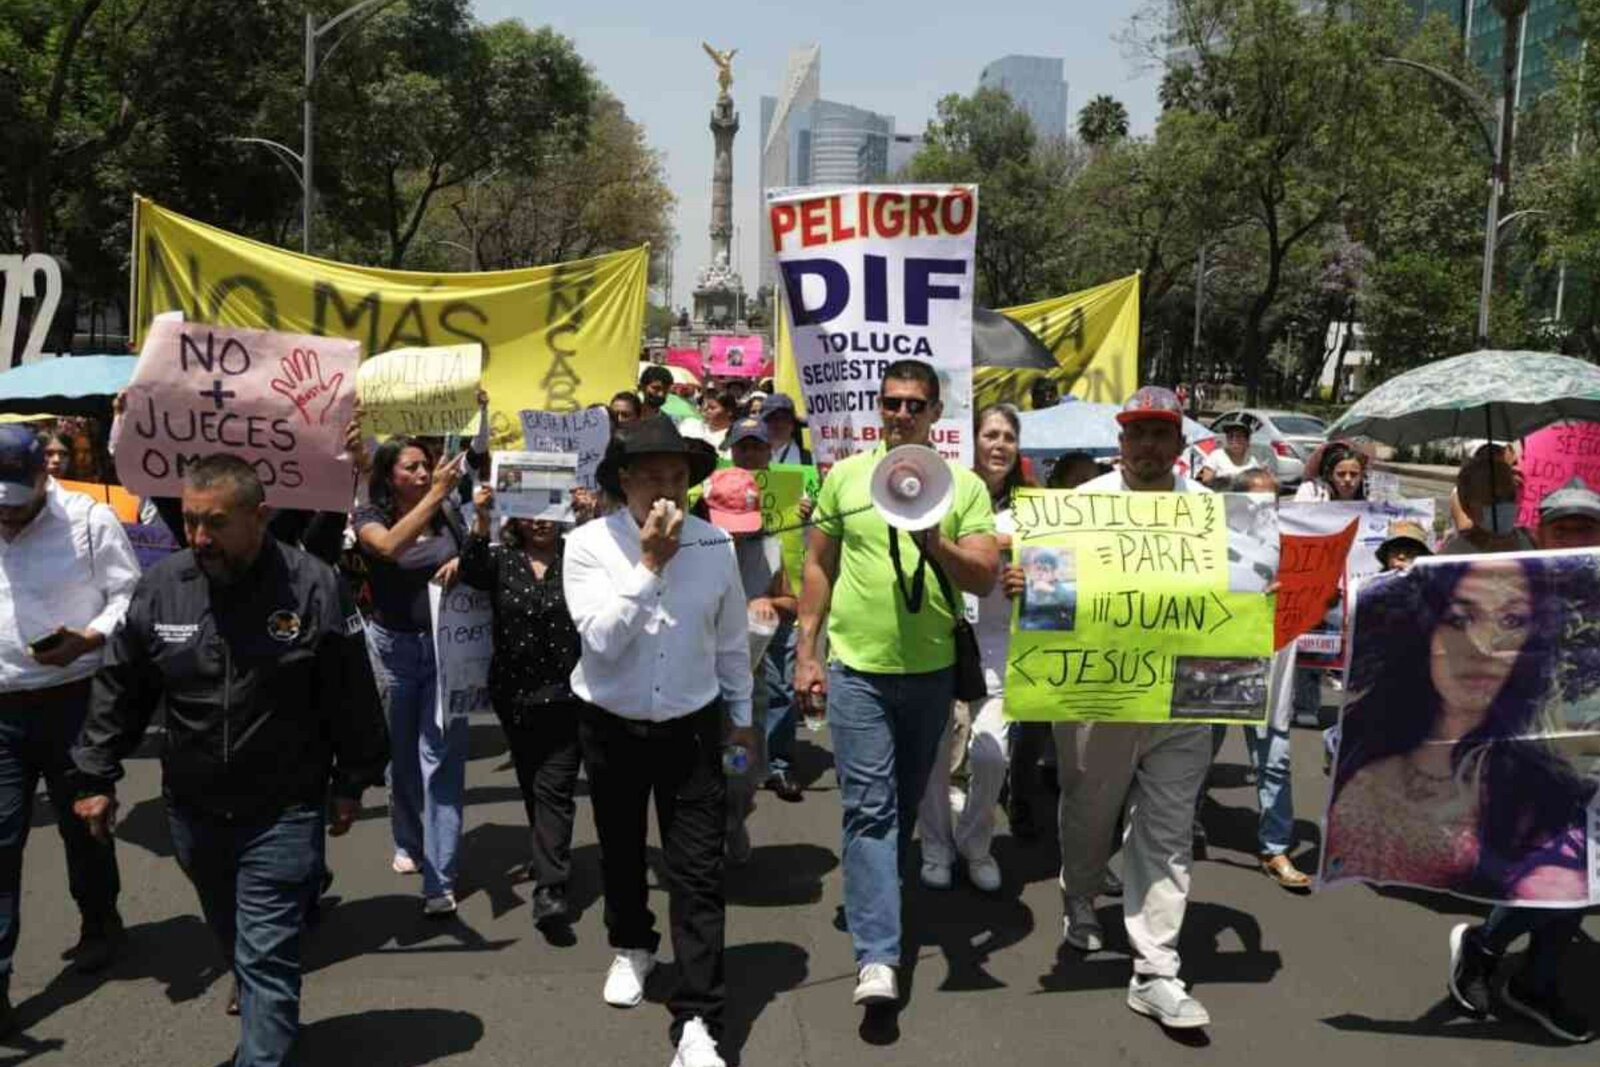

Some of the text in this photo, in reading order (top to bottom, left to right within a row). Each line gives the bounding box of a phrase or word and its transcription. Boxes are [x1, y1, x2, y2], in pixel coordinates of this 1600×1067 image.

[770, 189, 973, 252] PELIGRO
[780, 253, 966, 326] DIF
[180, 331, 250, 375] NO
[817, 331, 933, 357] TOLUCA
[803, 359, 890, 386] SECUESTR
[808, 390, 878, 416] JOVENCIT
[136, 397, 296, 451] JUECES
[142, 448, 303, 488] OMOS
[1016, 494, 1194, 527] JUSTICIA
[1117, 533, 1199, 573] PARA
